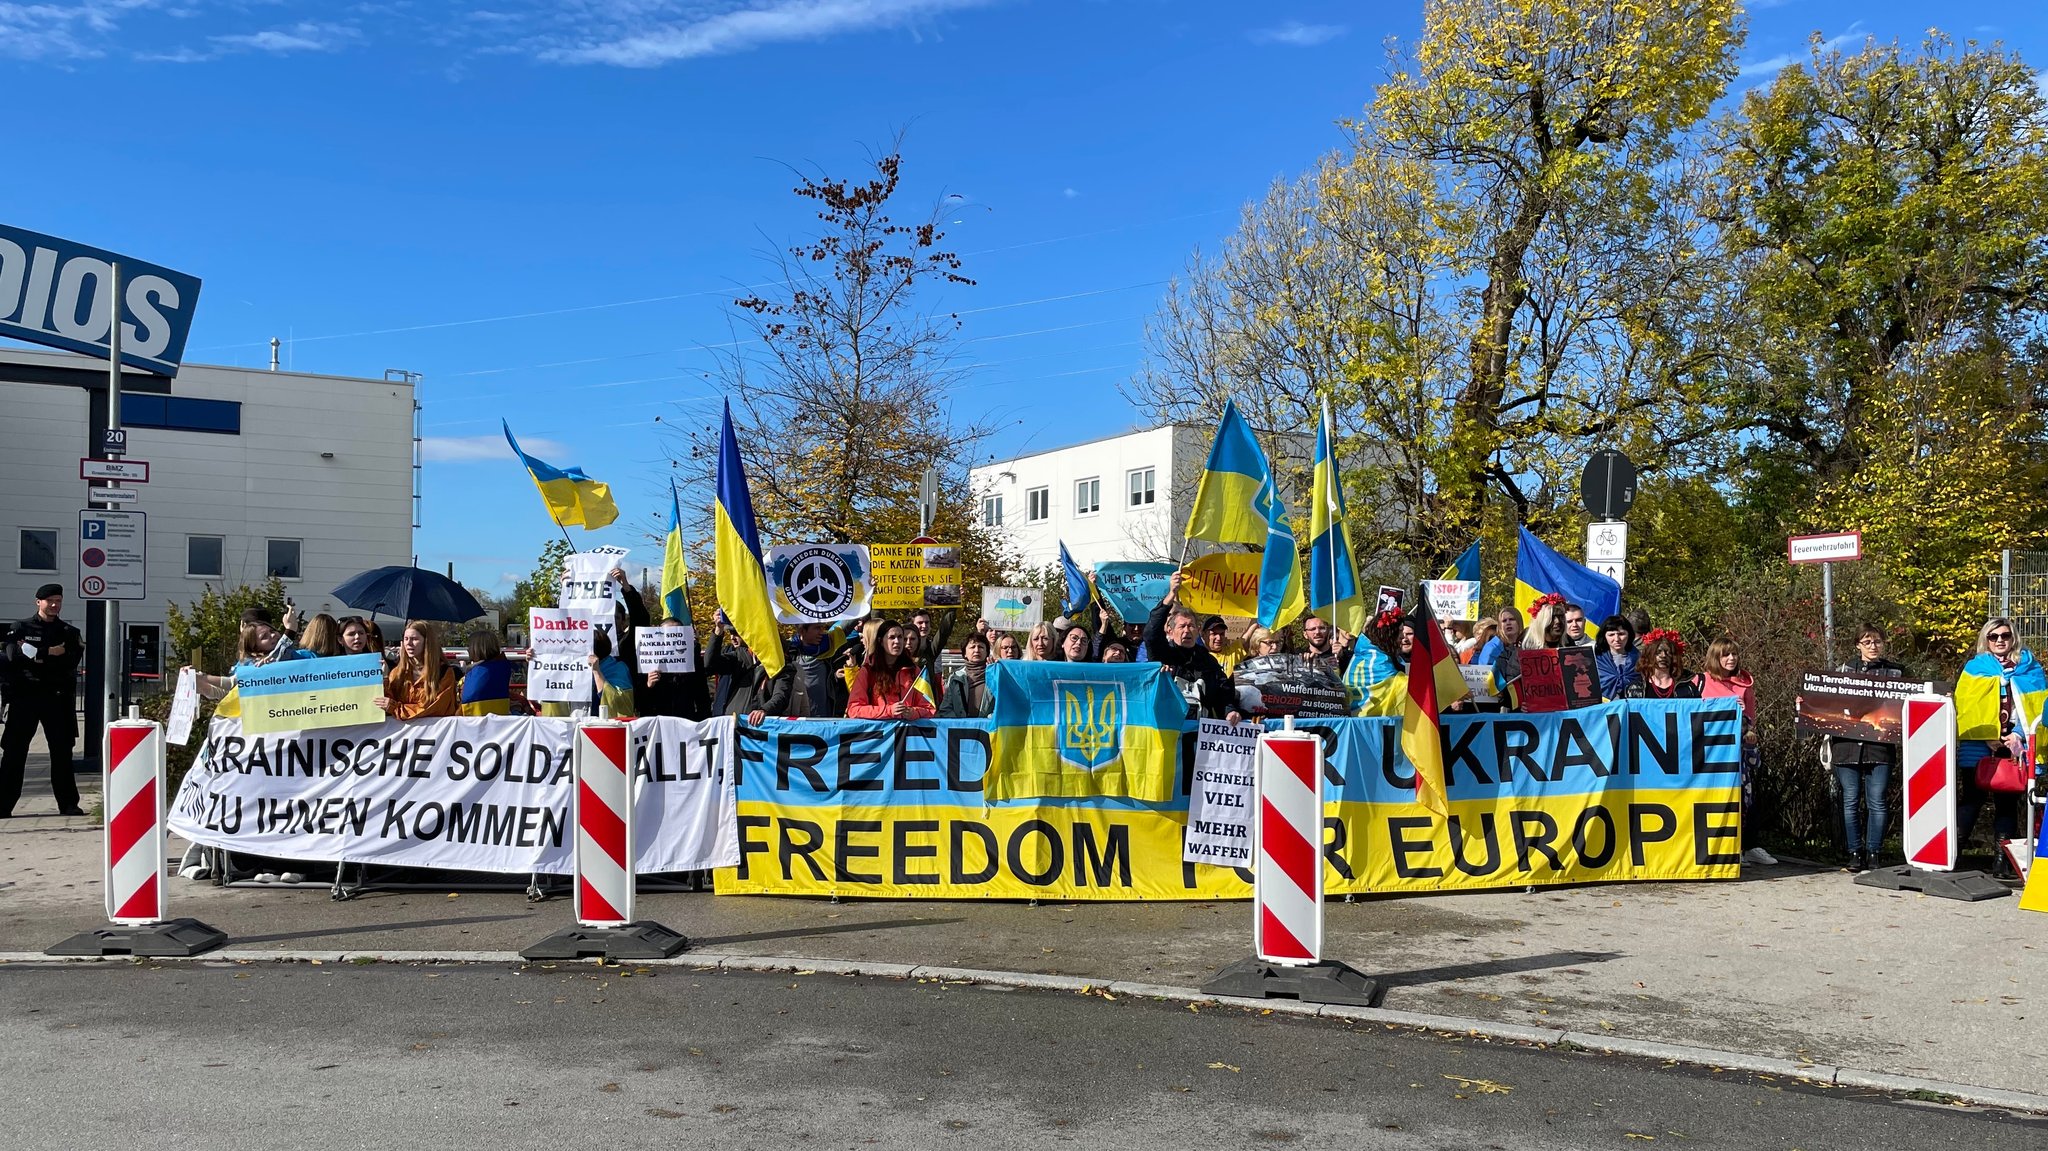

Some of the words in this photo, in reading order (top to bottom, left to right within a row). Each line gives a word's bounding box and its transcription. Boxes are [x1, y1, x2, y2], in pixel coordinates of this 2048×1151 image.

[0, 237, 180, 358] IOS
[106, 431, 124, 443] 20
[88, 522, 100, 537] P
[872, 547, 902, 556] DANKE
[1600, 548, 1613, 556] frei
[1794, 541, 1855, 554] Feuerwehrzufahrt
[789, 549, 819, 569] FRIEDEN
[821, 549, 844, 567] DURCH
[872, 560, 886, 569] DIE
[890, 560, 921, 569] KATZEN
[87, 580, 100, 591] 10
[873, 574, 897, 583] BITTE
[898, 574, 935, 584] SCHICKEN
[939, 574, 953, 583] SIE
[1124, 573, 1138, 584] DIE
[566, 580, 613, 600] THE
[873, 586, 893, 595] AUCH
[896, 586, 921, 595] DIESE
[784, 586, 823, 618] ÜBERLEGENE
[825, 584, 853, 618] FEUERKRAFT
[1436, 599, 1457, 609] WAR
[533, 616, 589, 631] Danke
[533, 660, 589, 672] Deutsch-
[1521, 656, 1560, 678] STOP
[237, 674, 286, 688] Schneller
[288, 667, 384, 684] Waffenlieferungen
[545, 679, 574, 690] land
[1804, 673, 1820, 682] Um
[1821, 674, 1873, 688] TerroRussia
[1886, 681, 1925, 692] STOPPE
[1281, 683, 1314, 695] Waffen
[1313, 687, 1336, 697] liefern
[1523, 682, 1564, 699] KREMLIN
[1803, 683, 1838, 694] Ukraine
[1838, 685, 1874, 697] braucht
[1261, 694, 1302, 706] GENOZID
[268, 706, 318, 718] Schneller
[319, 702, 359, 714] Frieden
[1298, 710, 1319, 718] ernst
[1201, 723, 1261, 739] UKRAINE
[735, 724, 993, 792] FREED
[1382, 709, 1737, 789] UKRAINE
[204, 736, 437, 779] KRAINISCHE
[446, 739, 574, 786] SOLDA
[634, 735, 725, 786] ÄLLT,
[1204, 791, 1245, 808] VIEL
[205, 791, 243, 835] ZU
[257, 797, 372, 837] IHNEN
[380, 799, 568, 848] KOMMEN
[1194, 820, 1248, 838] MEHR
[736, 815, 1133, 888] FREEDOM
[1388, 801, 1741, 879] EUROPE
[1188, 842, 1250, 859] WAFFEN
